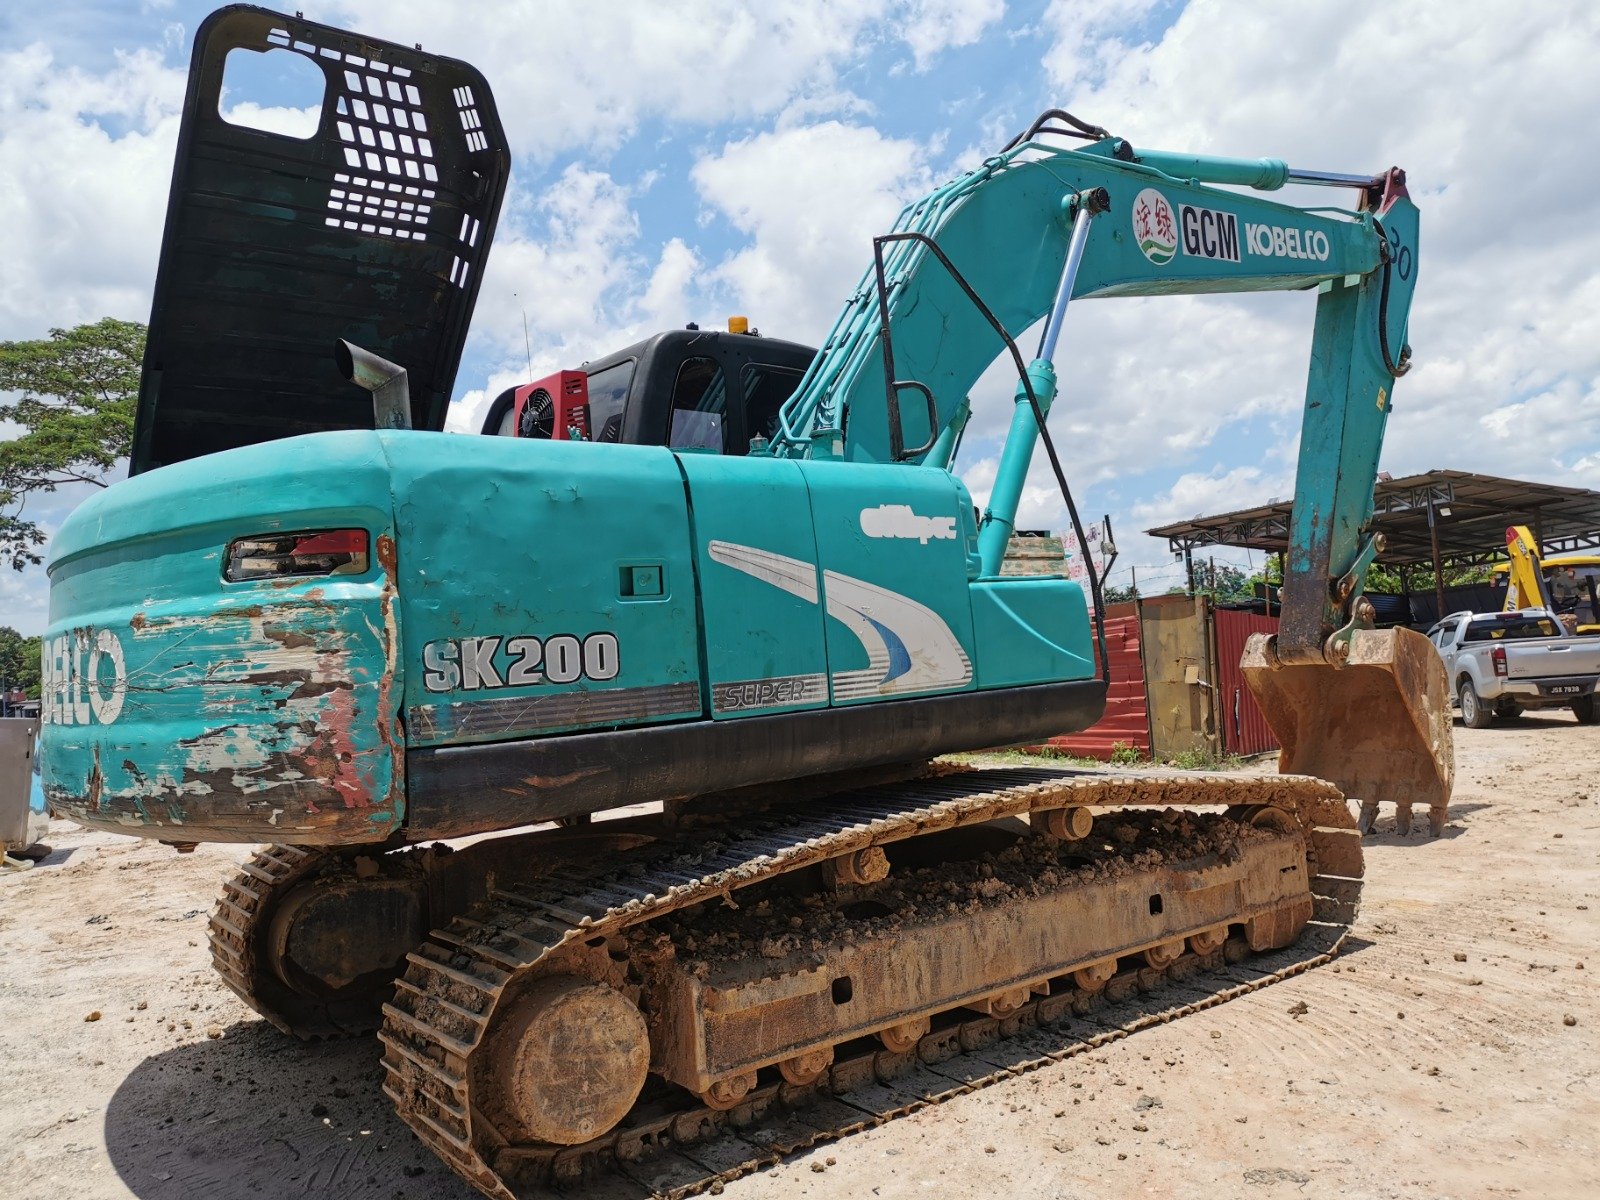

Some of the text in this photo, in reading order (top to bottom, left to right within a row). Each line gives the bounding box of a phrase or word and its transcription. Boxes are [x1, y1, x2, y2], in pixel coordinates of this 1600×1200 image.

[1181, 204, 1241, 261] GCM
[1244, 223, 1330, 262] KOBELCO
[422, 631, 620, 692] SK200
[723, 680, 805, 708] SUPER
